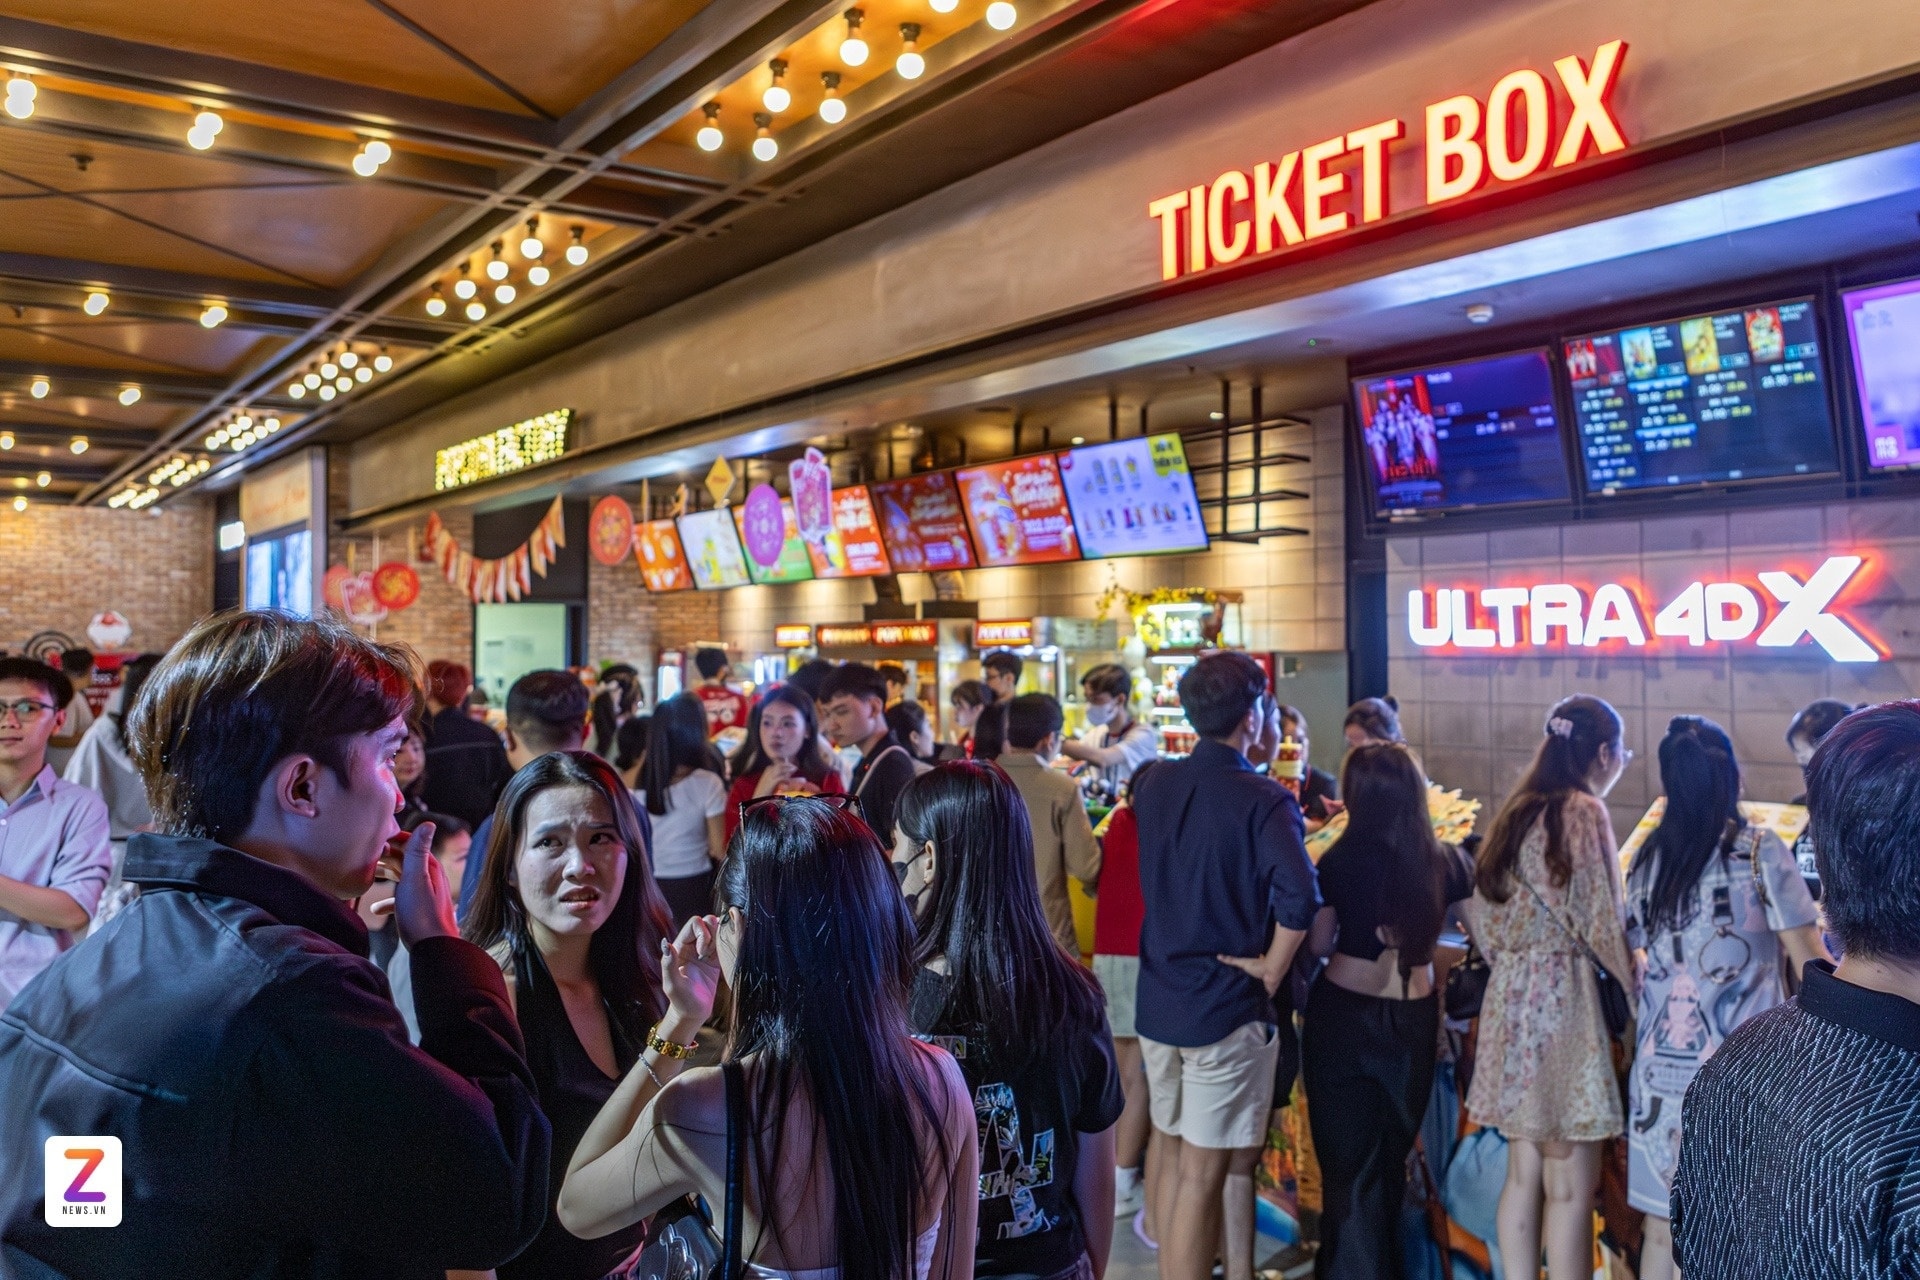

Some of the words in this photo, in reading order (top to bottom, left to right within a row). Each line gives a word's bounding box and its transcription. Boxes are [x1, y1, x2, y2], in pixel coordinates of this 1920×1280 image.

[1149, 118, 1403, 281] TICKET
[1425, 39, 1627, 205] BOX
[1408, 583, 1646, 648] ULTRA
[1655, 556, 1880, 662] 4DX
